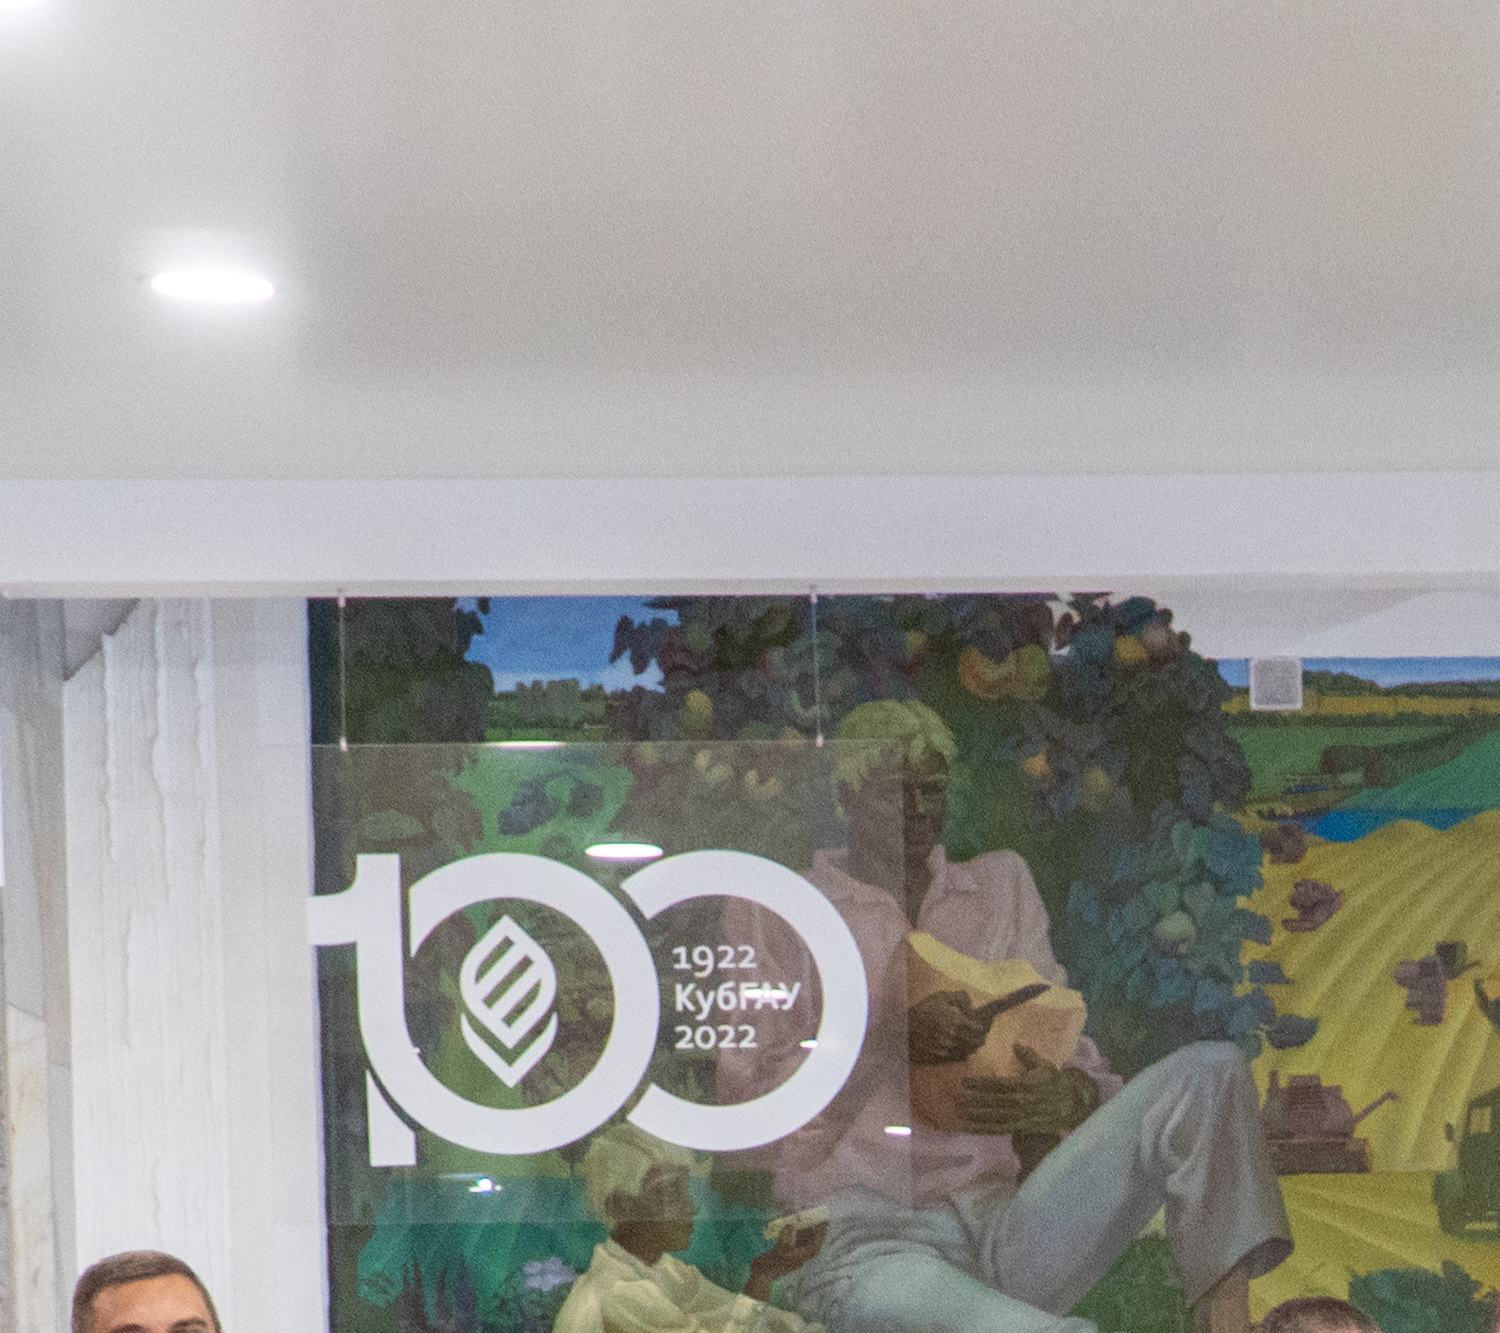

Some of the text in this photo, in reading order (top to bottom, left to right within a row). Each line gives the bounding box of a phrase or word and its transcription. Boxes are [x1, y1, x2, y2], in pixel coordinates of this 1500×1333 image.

[672, 944, 757, 978] 1922
[674, 980, 801, 1021] КубГАУ
[674, 1024, 758, 1050] 2022
